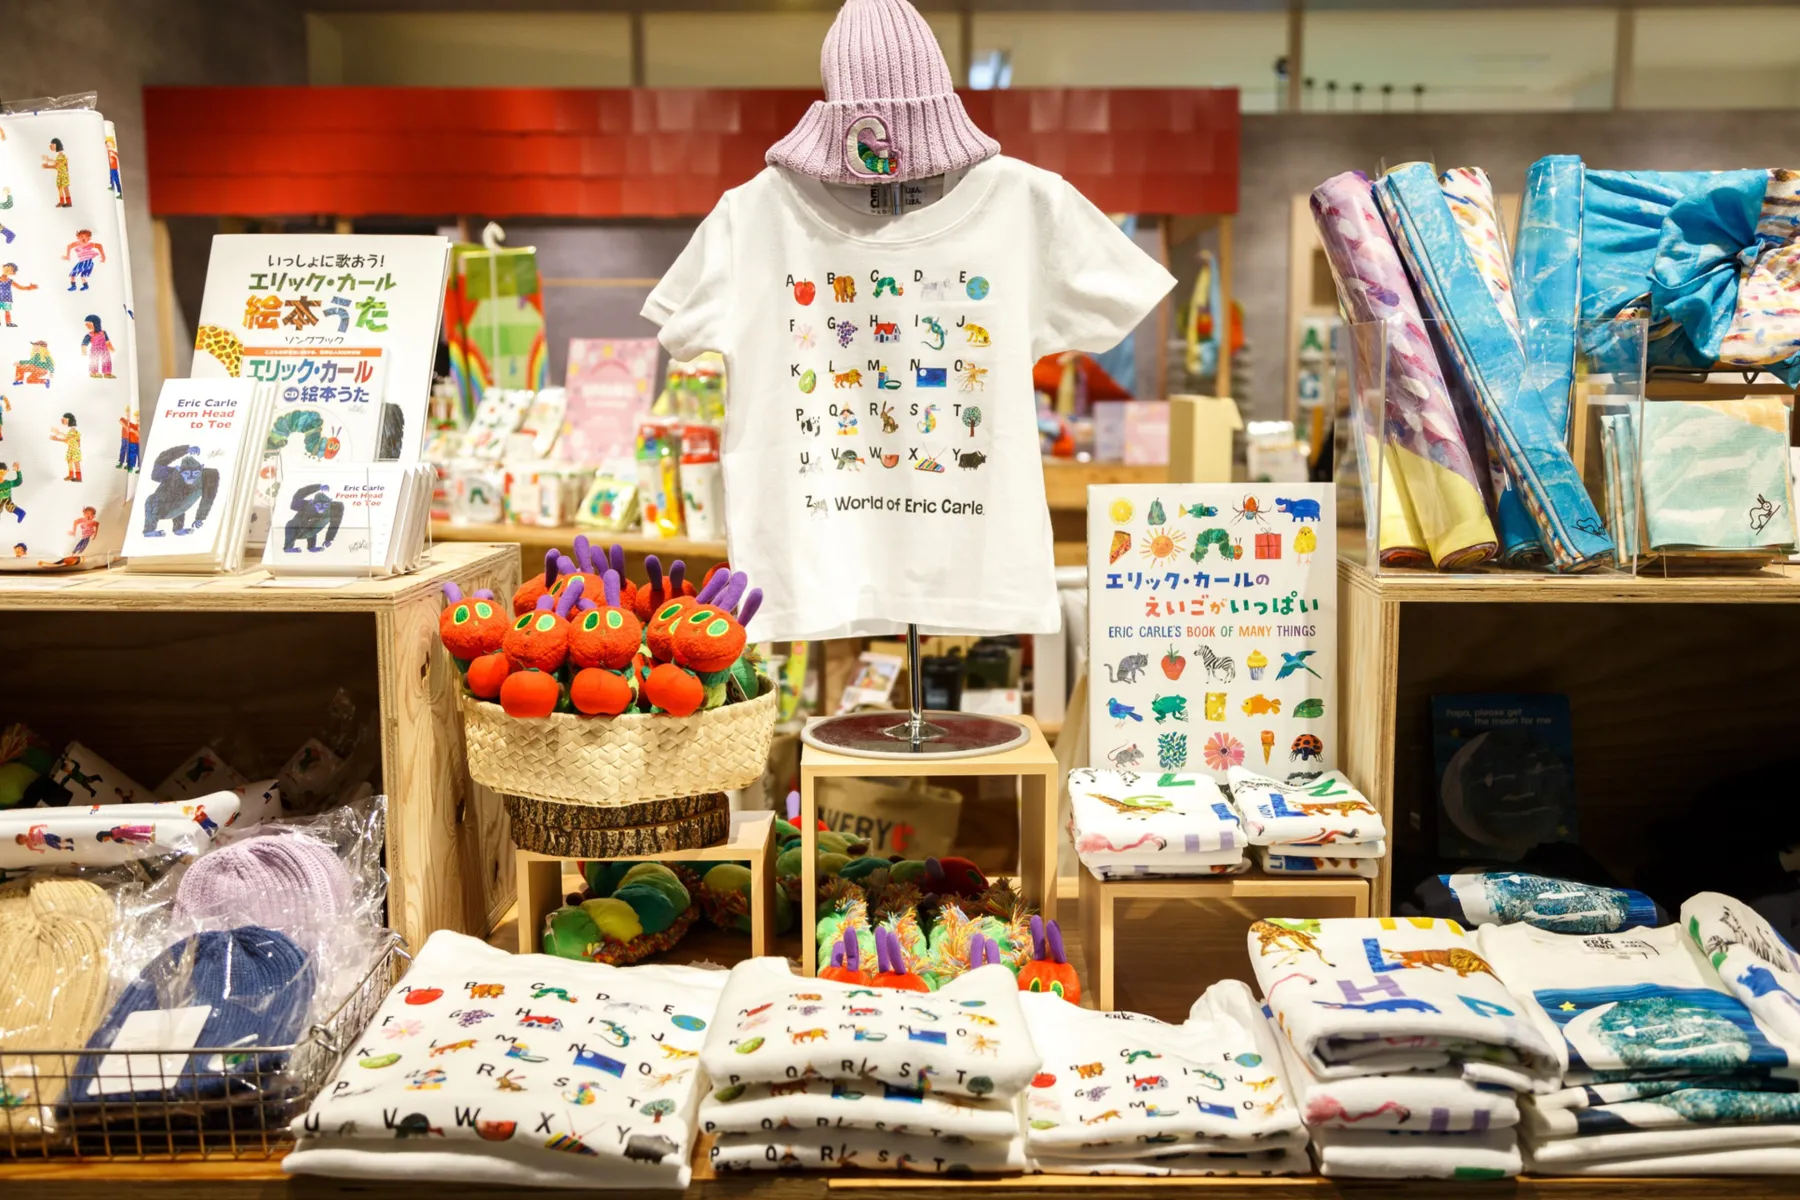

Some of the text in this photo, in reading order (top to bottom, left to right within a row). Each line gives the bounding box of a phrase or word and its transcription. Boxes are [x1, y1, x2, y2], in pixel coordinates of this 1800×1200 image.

[268, 254, 385, 268] いっしょに歌おう!
[249, 272, 397, 292] エリック・カール
[786, 270, 967, 287] A B C D E
[242, 294, 389, 333] 絵本うた
[789, 315, 965, 332] F G H I J
[247, 358, 374, 384] エリック・カール
[791, 360, 963, 376] K L M N O
[177, 399, 238, 407] Eric Carle
[301, 386, 370, 403] 絵本うた
[165, 410, 235, 418] From Head
[796, 404, 961, 421] P Q R S T
[190, 420, 232, 429] to Toe
[801, 447, 960, 464] U V W X Y
[335, 492, 358, 500] From
[835, 496, 883, 511] World
[887, 498, 900, 511] of
[905, 499, 936, 513] Eric
[1105, 571, 1270, 591] エリック・カールの
[1144, 590, 1319, 618] えいごがいっぱい
[1108, 625, 1316, 638] ERIC CARLE'S BOOK OF MANY THINGS
[398, 982, 674, 1015] A B C D E
[382, 1015, 394, 1027] F
[515, 1008, 531, 1017] H
[651, 1033, 665, 1042] J
[356, 1047, 375, 1058] K
[495, 1034, 518, 1043] M
[568, 1044, 586, 1052] N
[730, 1060, 966, 1085] P Q R S T
[1126, 1074, 1136, 1083] H
[333, 1081, 349, 1094] P
[476, 1063, 495, 1077] R
[554, 1077, 570, 1087] S
[627, 1096, 641, 1108] T
[1187, 1096, 1199, 1105] N
[304, 1106, 631, 1144] U V W X Y
[711, 1145, 944, 1172] P Q R S T
